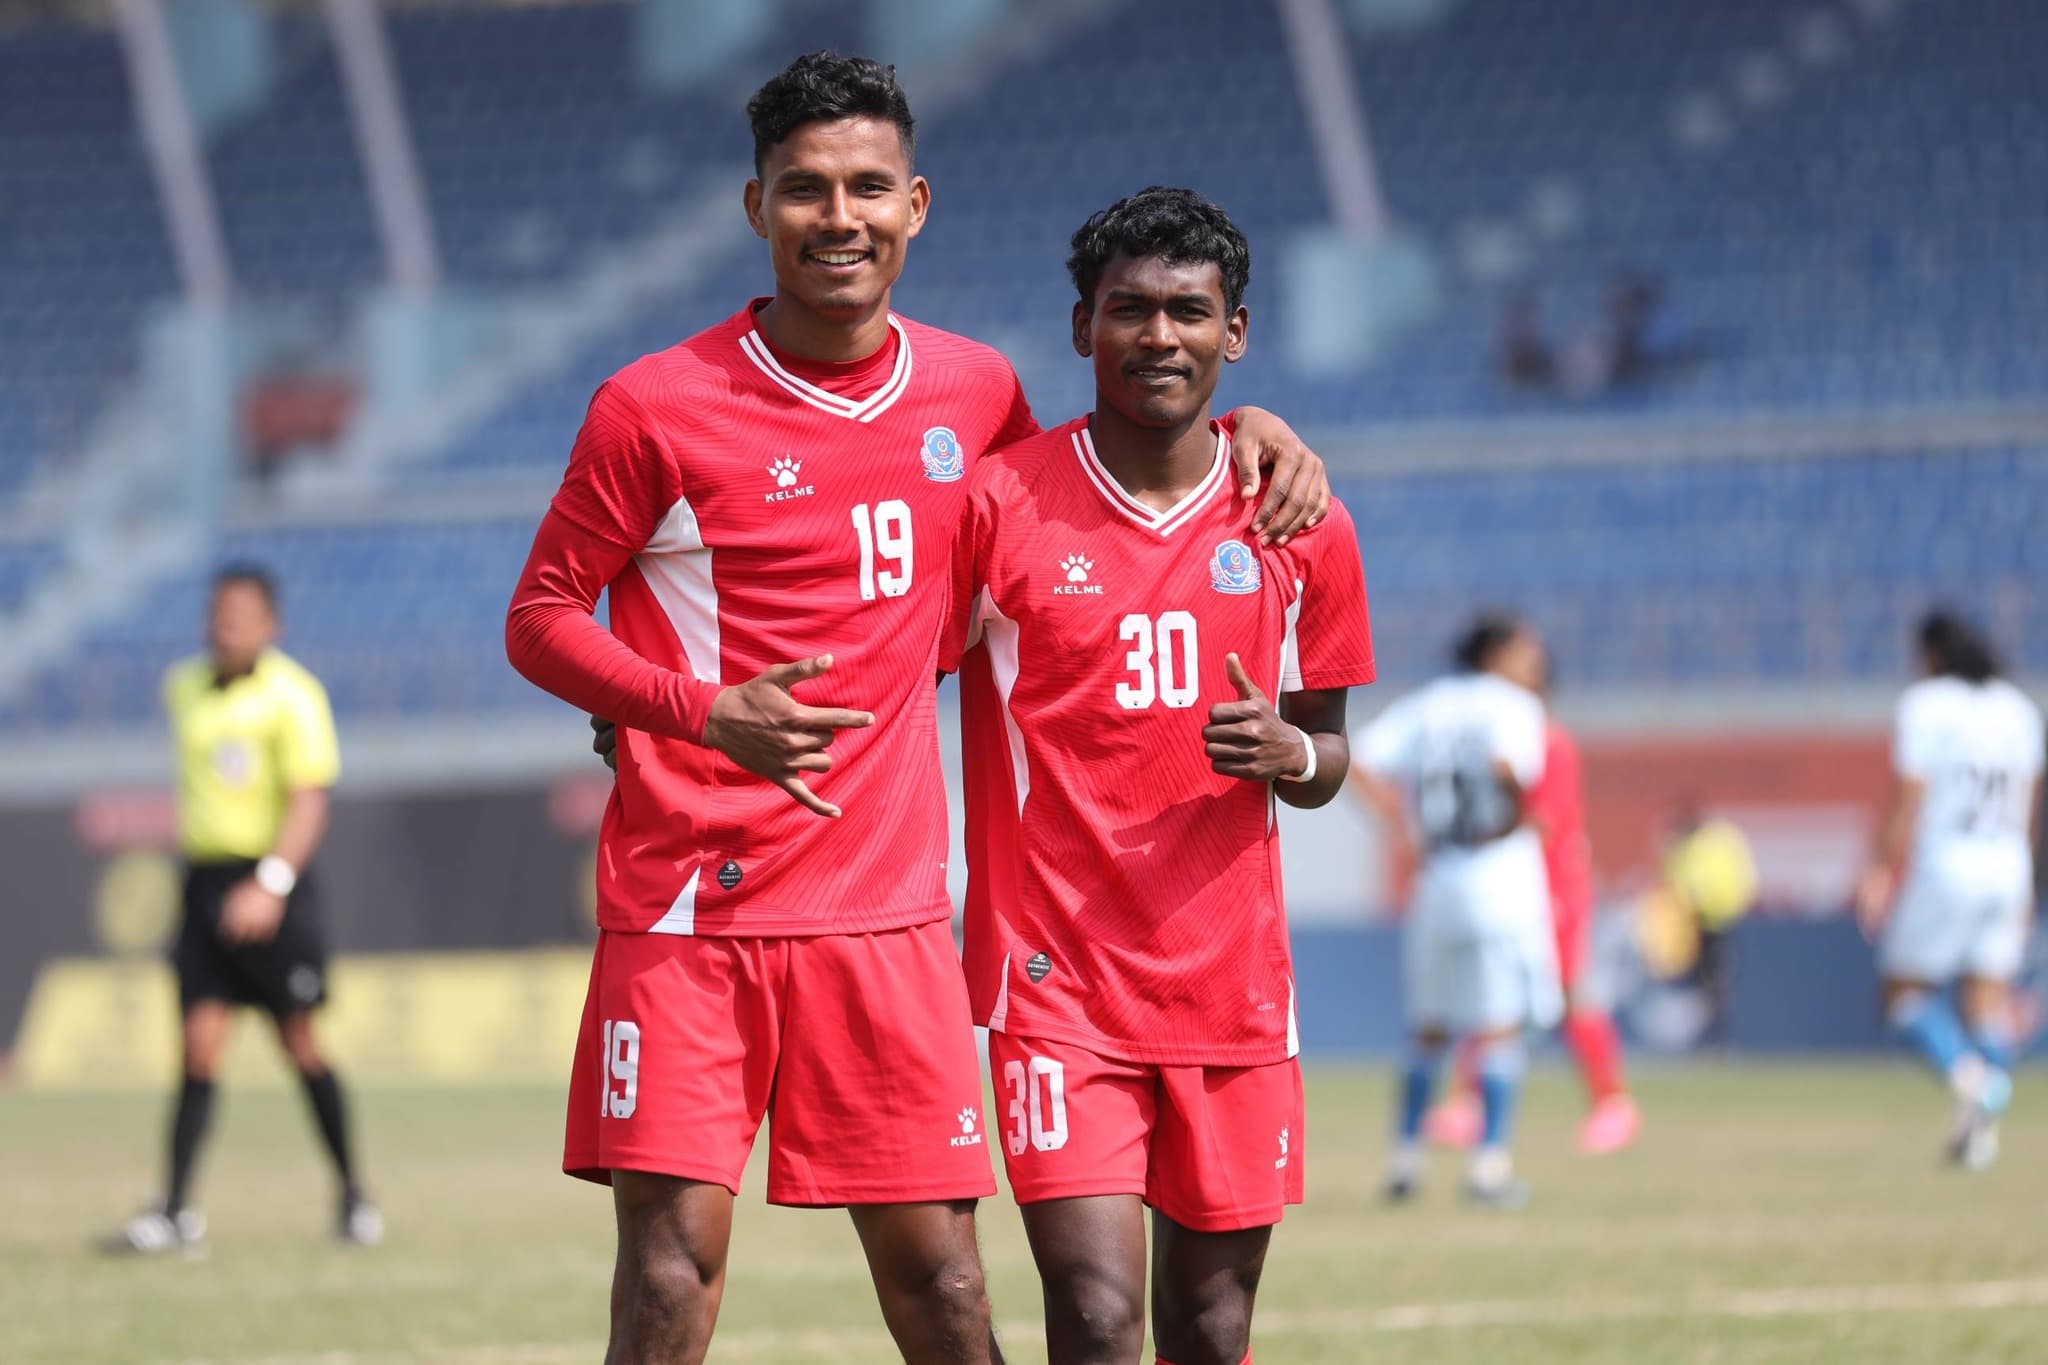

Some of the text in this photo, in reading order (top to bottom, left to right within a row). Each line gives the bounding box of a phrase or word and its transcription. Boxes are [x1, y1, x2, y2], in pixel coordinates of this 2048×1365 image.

[764, 485, 815, 503] KELME
[851, 499, 914, 601] 19
[1053, 585, 1104, 595] KELME
[1115, 610, 1200, 710] 30
[601, 1019, 640, 1119] 19
[1004, 1056, 1069, 1156] 30
